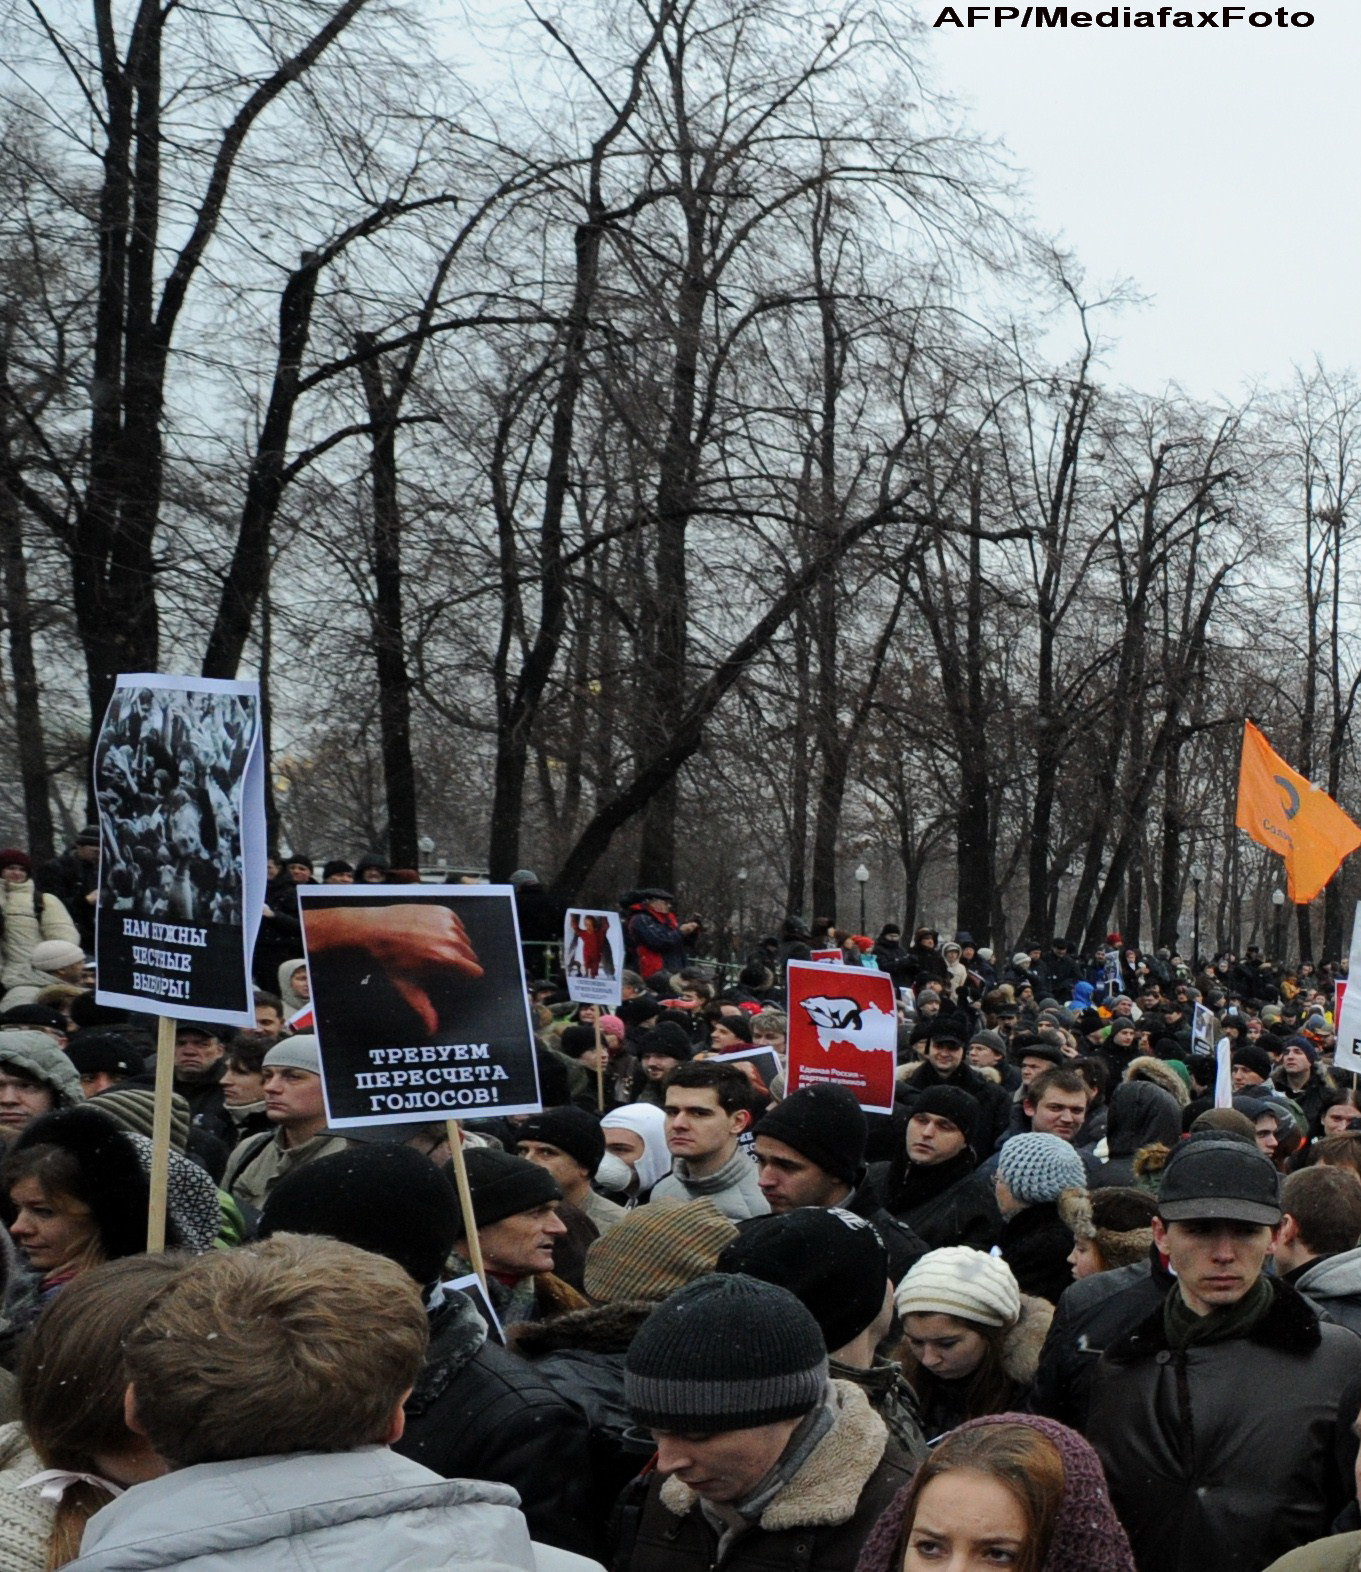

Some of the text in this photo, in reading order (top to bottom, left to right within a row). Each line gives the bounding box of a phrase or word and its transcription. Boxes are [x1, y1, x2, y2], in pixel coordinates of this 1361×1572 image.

[122, 918, 208, 948] НАМ НУЖНЫ
[132, 946, 192, 973] ЧЕСТНЫЕ
[132, 972, 191, 1000] ВЫБОРЫ!
[369, 1043, 491, 1065] ТРЕБУЕМ
[355, 1065, 510, 1089] ПЕРЕСЧЕТА
[370, 1087, 499, 1111] ГОЛОСОВ!
